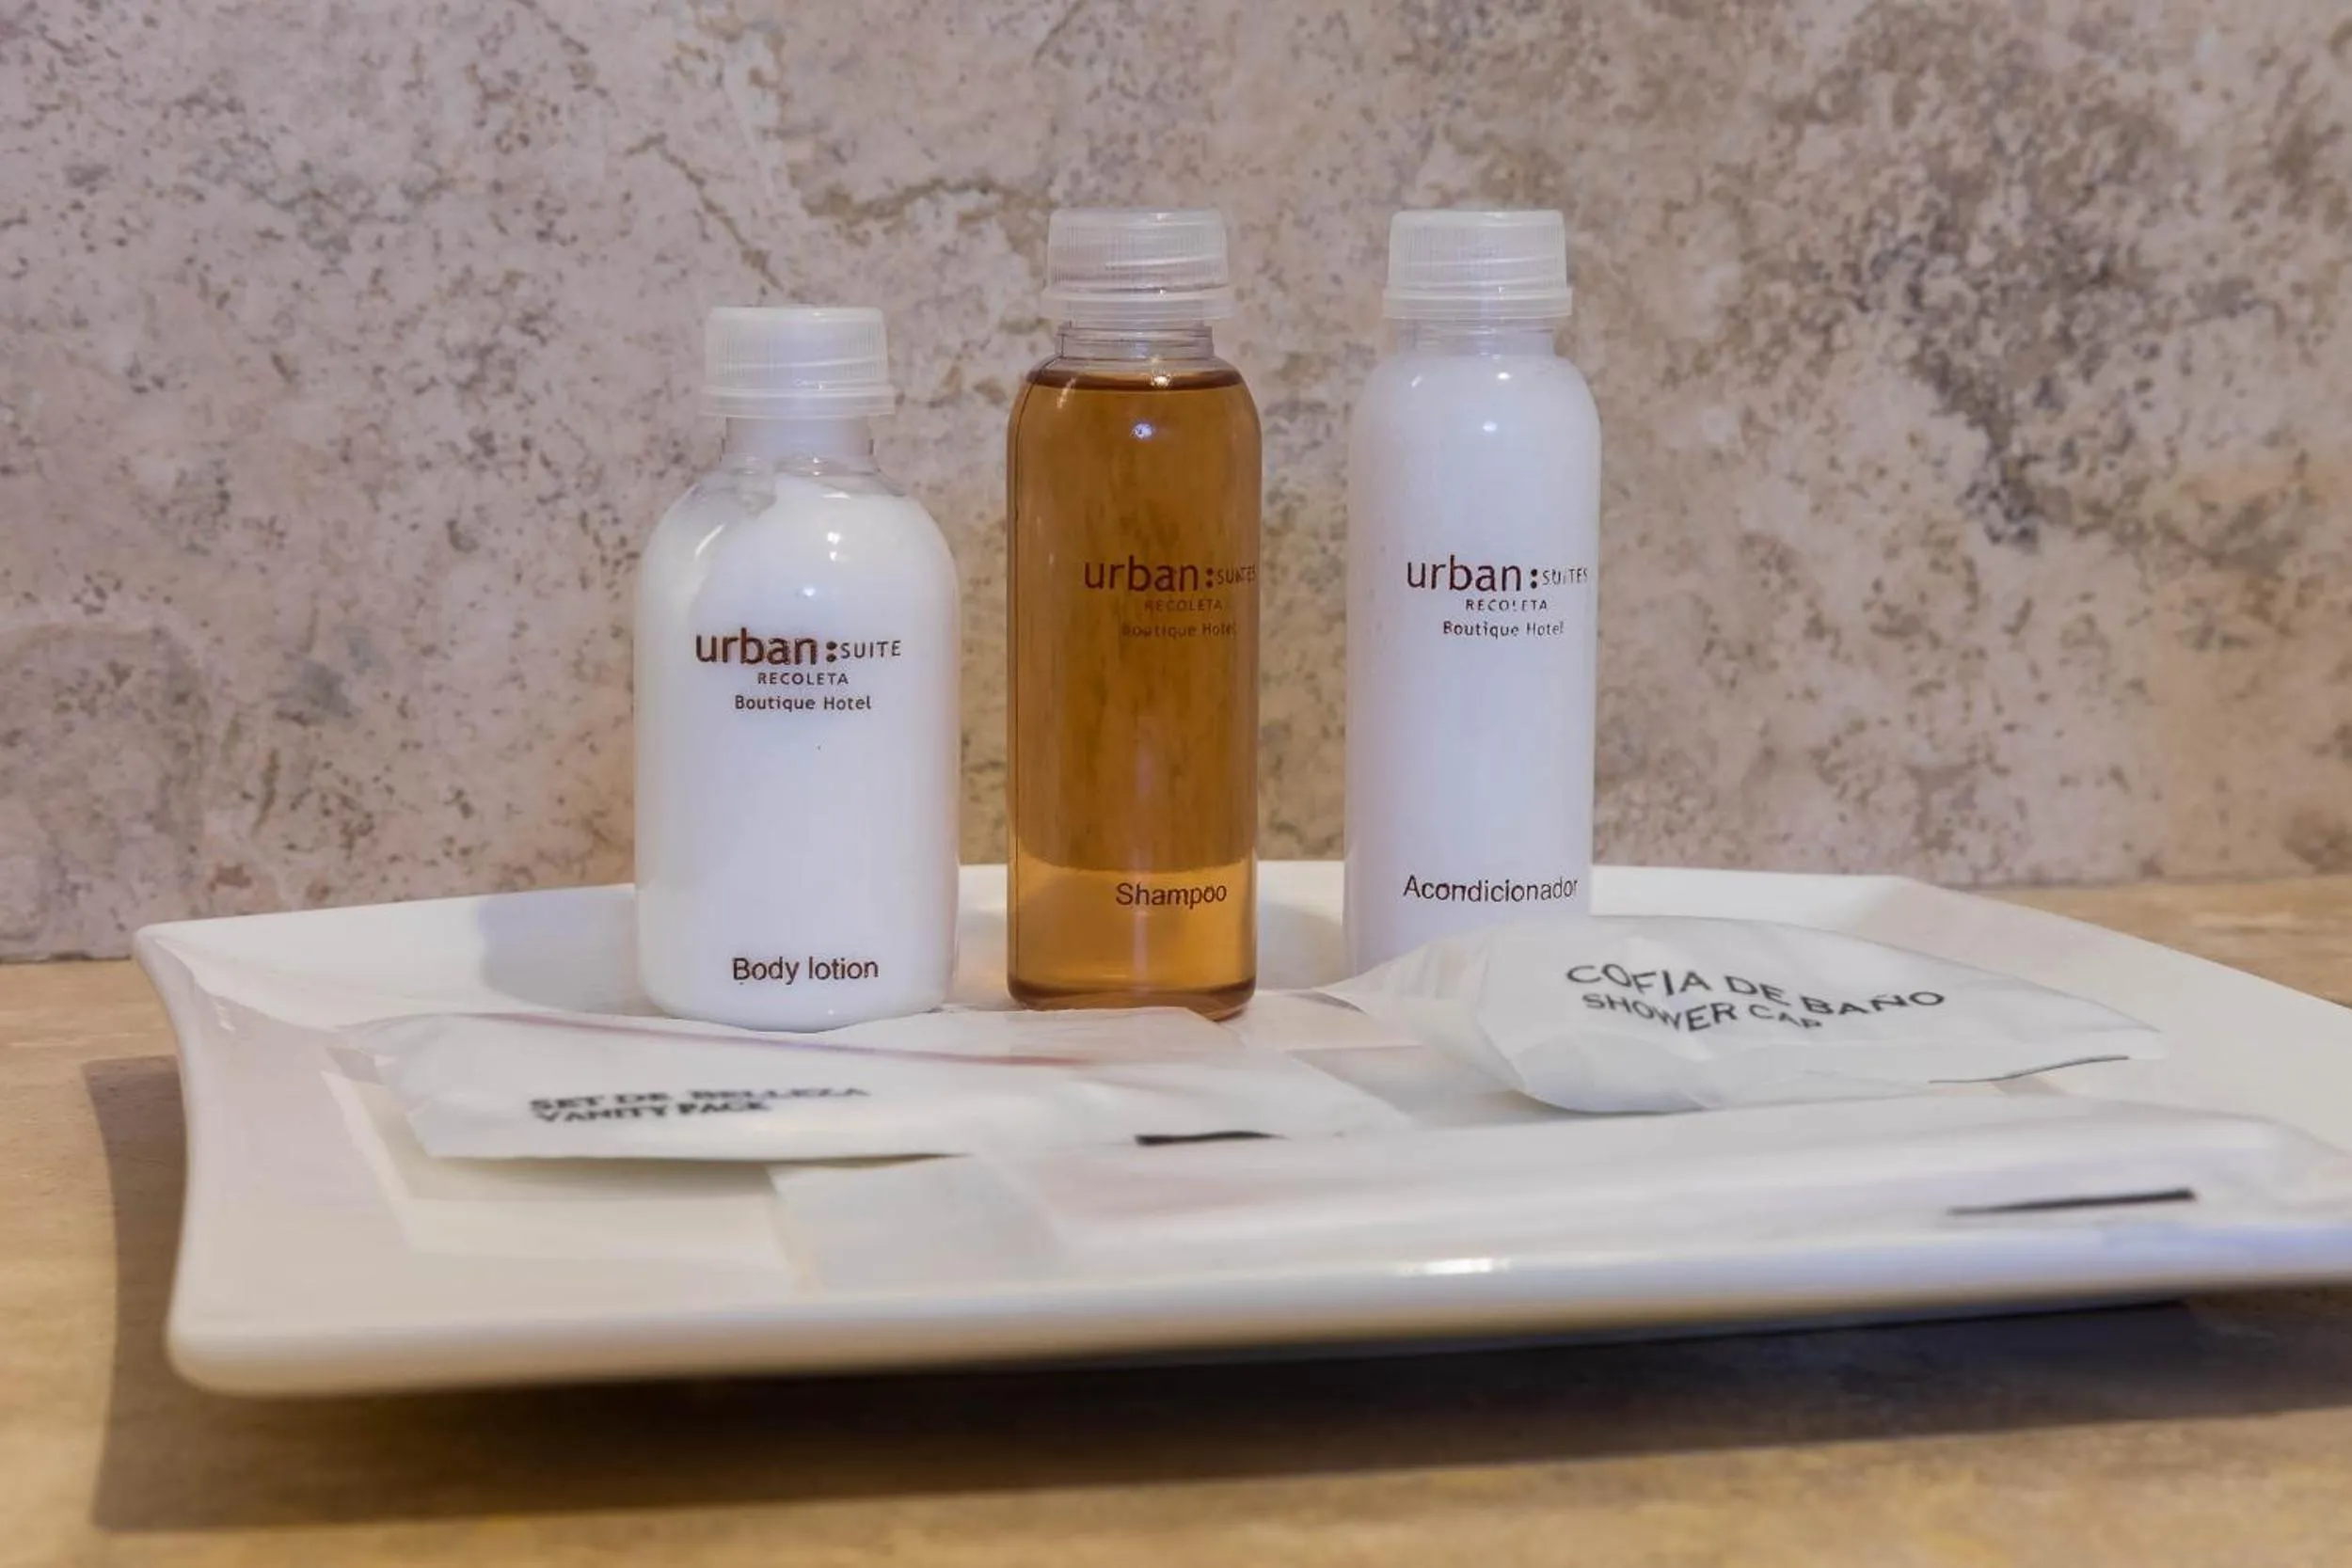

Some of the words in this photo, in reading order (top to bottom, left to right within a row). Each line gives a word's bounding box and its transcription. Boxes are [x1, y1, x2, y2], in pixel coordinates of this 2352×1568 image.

[1143, 598, 1223, 611] RECOLETA
[1465, 598, 1549, 611] RECOLETA
[1121, 623, 1198, 640] Boutique
[1442, 621, 1520, 639] Boutique
[1526, 621, 1565, 636] Hotel
[757, 672, 850, 686] RECOLETA
[734, 695, 816, 713] Boutique
[823, 695, 871, 711] Hotel
[1115, 882, 1228, 910] Shampoo
[1403, 874, 1578, 903] Acondicionador
[732, 956, 800, 985] Body
[807, 956, 880, 981] lotion
[1565, 963, 1712, 996] COFIA
[1724, 974, 1792, 1006] DE
[1799, 990, 1946, 1017] BAÑO
[1581, 992, 1739, 1033] SHOWER
[1747, 1003, 1824, 1030] CAP
[530, 1094, 605, 1111] SET
[613, 1091, 672, 1105] DE
[533, 1105, 668, 1123] VANITY
